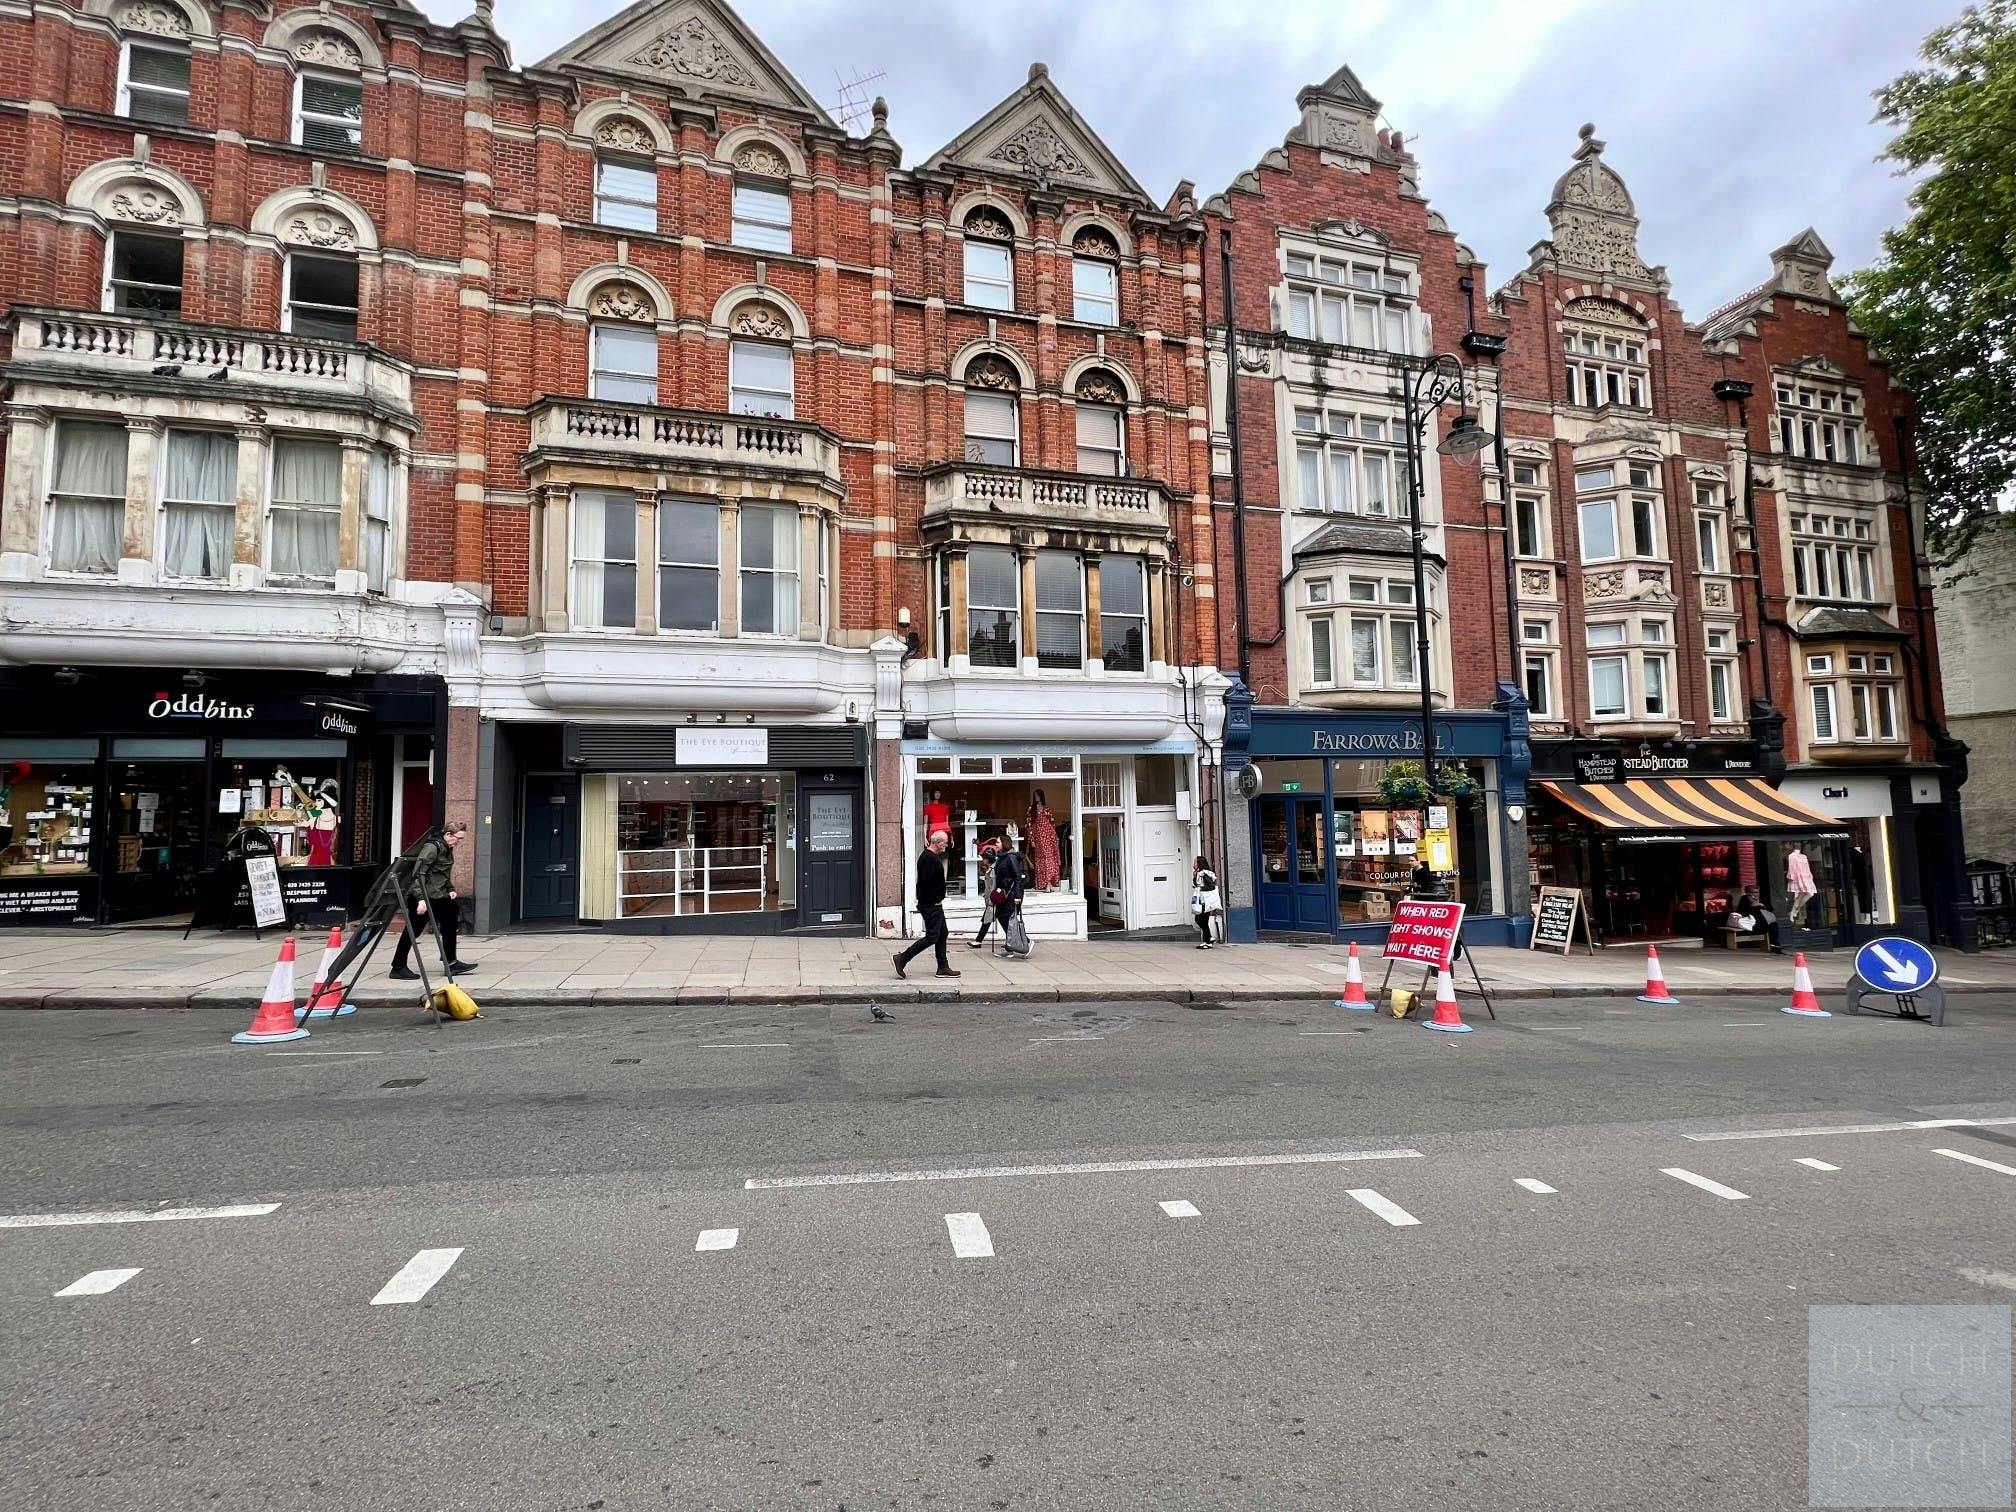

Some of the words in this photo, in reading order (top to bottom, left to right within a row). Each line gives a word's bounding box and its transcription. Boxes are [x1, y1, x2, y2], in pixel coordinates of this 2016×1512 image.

[149, 692, 254, 719] Oddbins
[322, 713, 357, 734] Oddbins
[1370, 870, 1399, 880] COLOUR
[1400, 906, 1427, 918] WHEN
[1429, 907, 1449, 919] RED
[1412, 925, 1454, 939] SHOWS
[1387, 942, 1407, 953] WAIT
[1408, 944, 1441, 960] HERE
